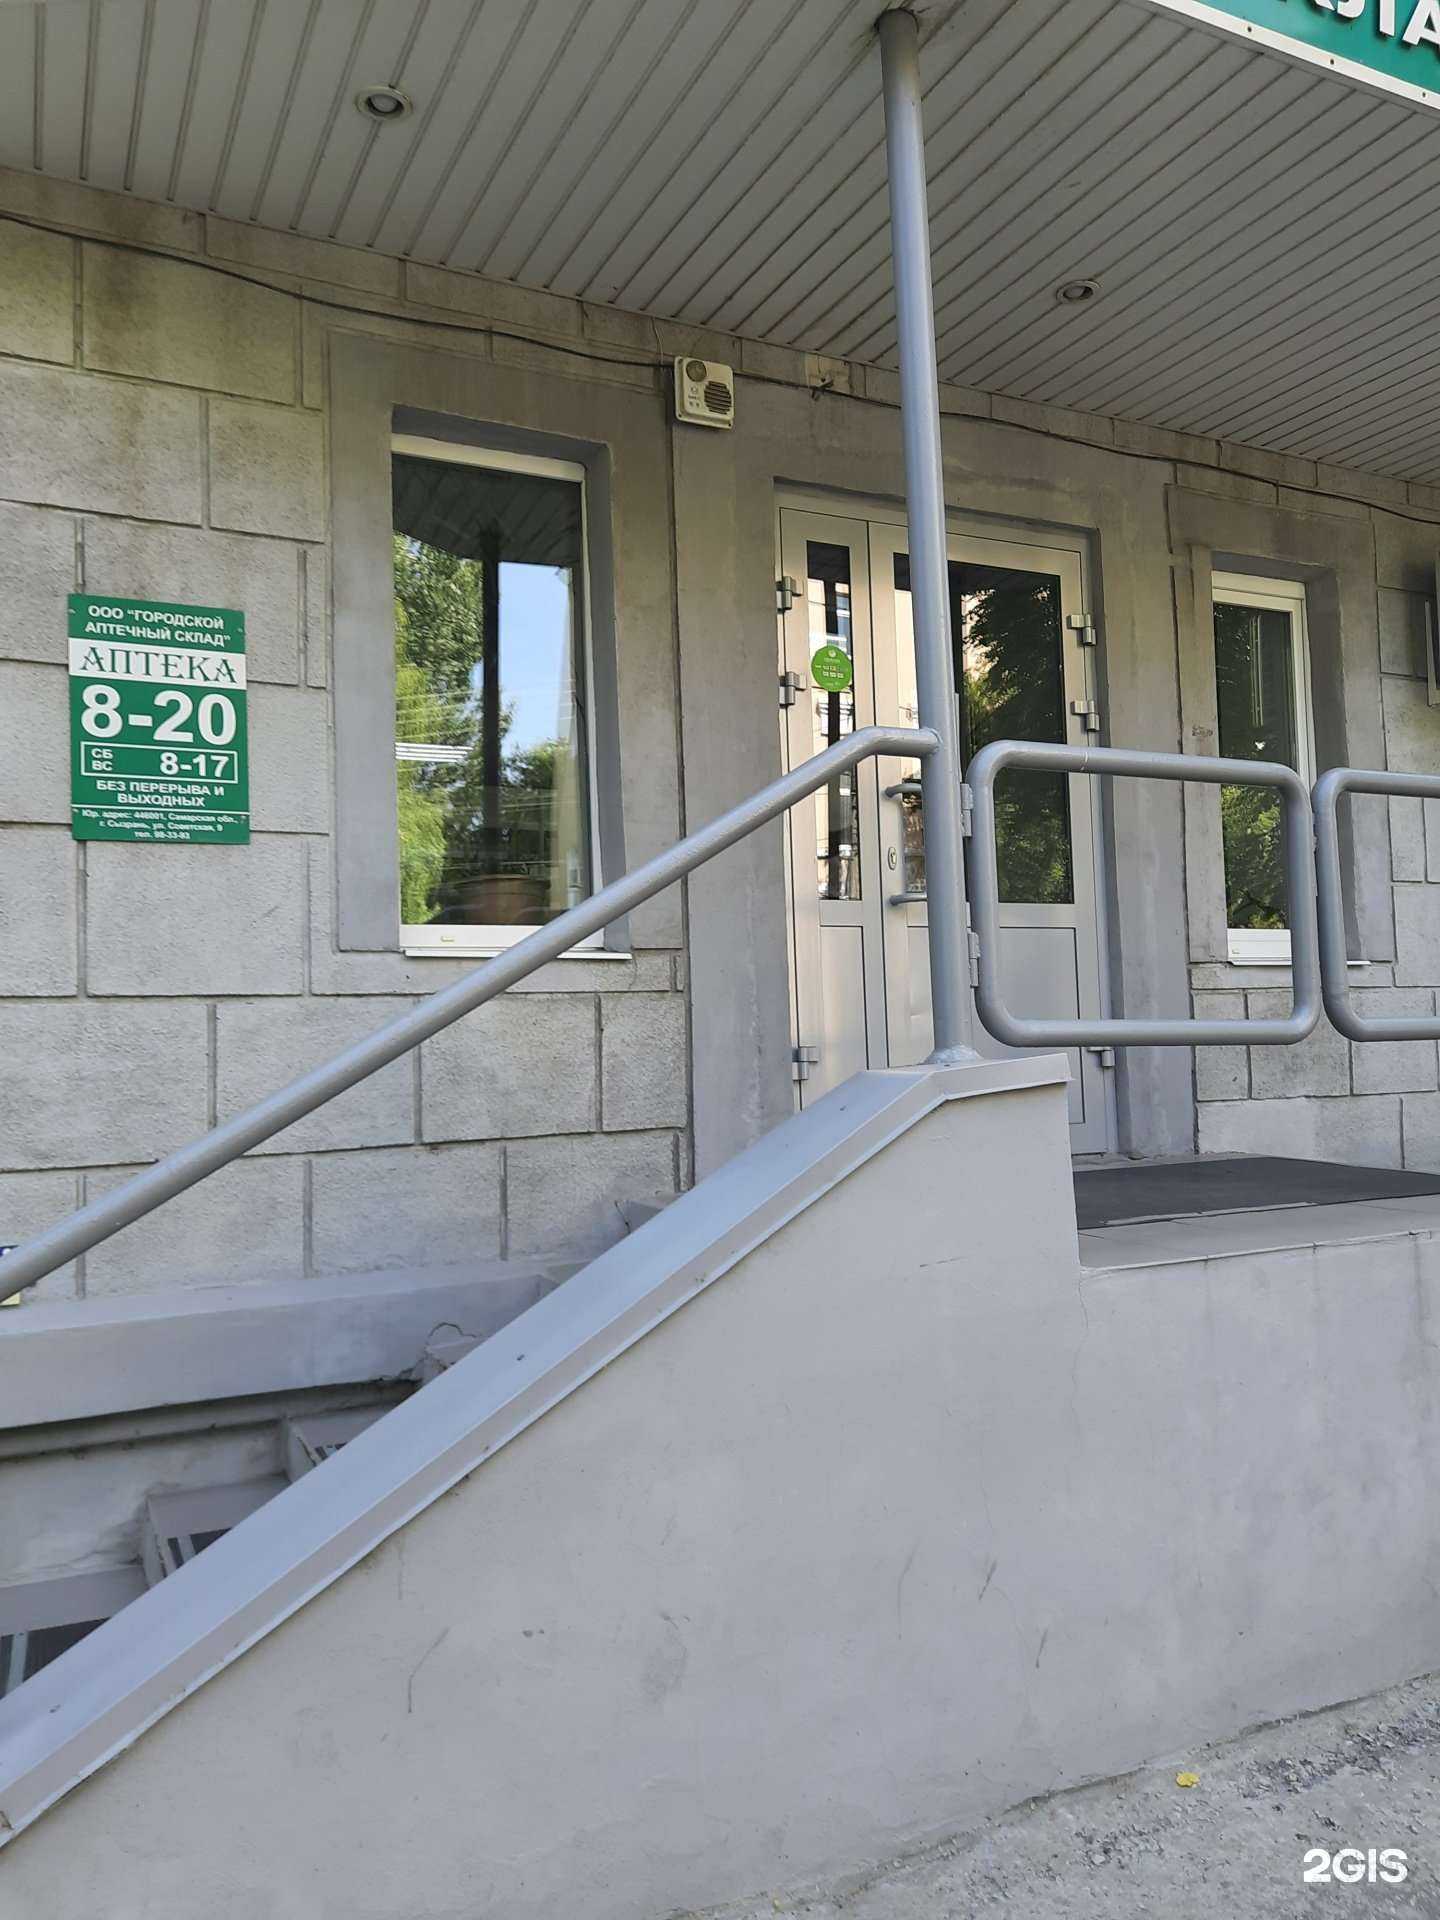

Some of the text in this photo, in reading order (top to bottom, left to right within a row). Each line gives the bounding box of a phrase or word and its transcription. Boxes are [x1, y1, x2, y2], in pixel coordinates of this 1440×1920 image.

[88, 605, 124, 619] ООО
[85, 621, 171, 640] АПТЕЧНЫЙ
[80, 646, 237, 683] АПТЕКА
[80, 684, 237, 746] 8-20
[91, 748, 113, 759] СБ
[92, 760, 112, 771] ВС
[160, 751, 229, 778] 8-17
[96, 780, 225, 796] БЕЗ ПЕРЕРЫВА И
[117, 793, 205, 807] ВЫХОДНЫХ
